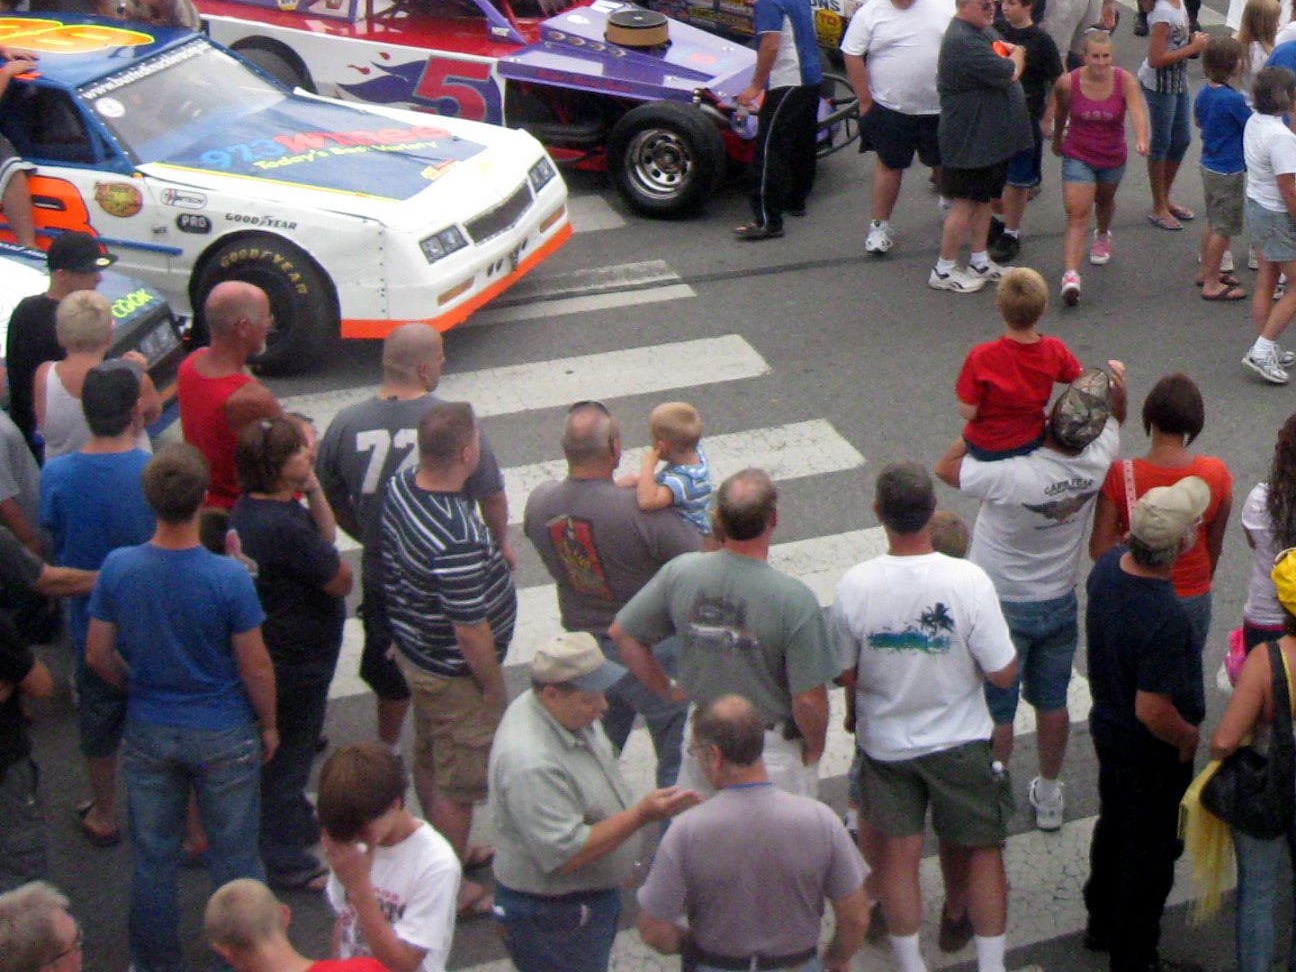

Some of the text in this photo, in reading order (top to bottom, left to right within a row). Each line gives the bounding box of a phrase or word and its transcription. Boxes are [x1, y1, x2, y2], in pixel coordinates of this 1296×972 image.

[412, 55, 493, 122] 5
[253, 148, 329, 170] Today's
[180, 214, 207, 228] PRO
[225, 212, 298, 230] GOODYEAR
[220, 248, 308, 295] GOODYEAR
